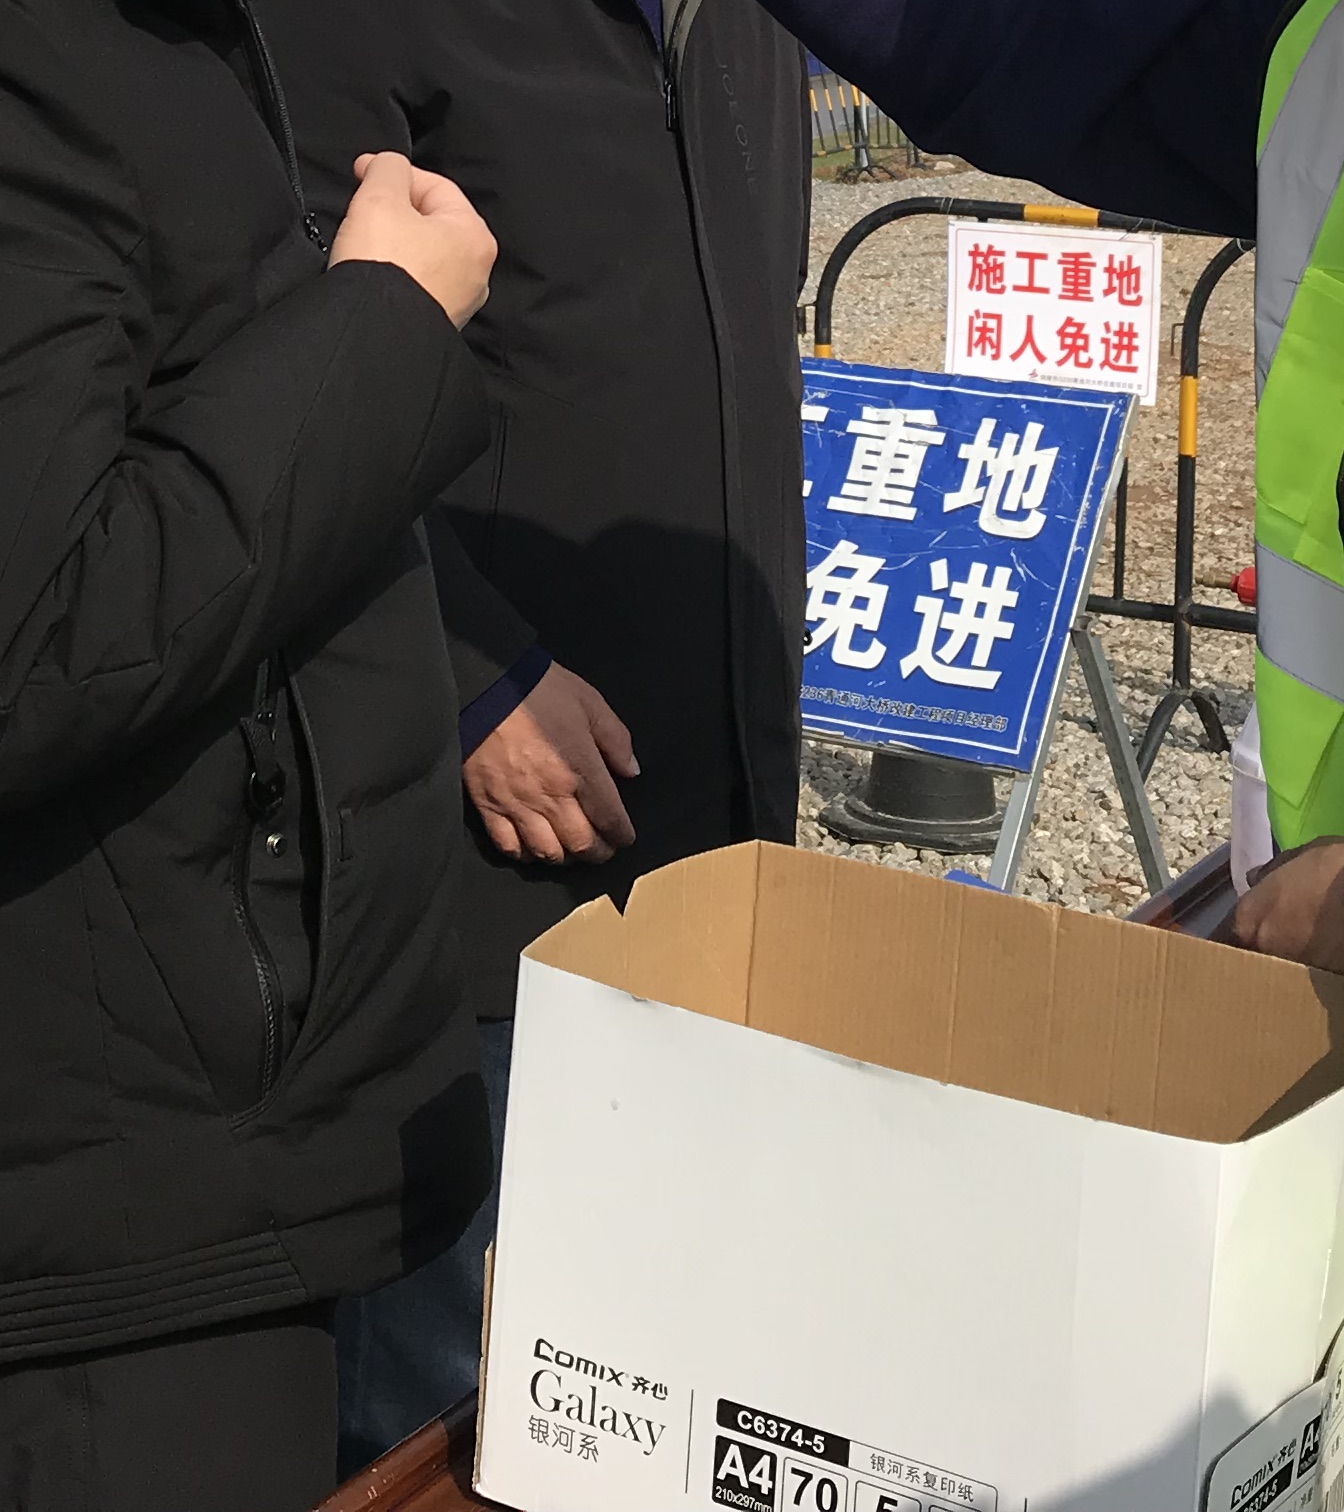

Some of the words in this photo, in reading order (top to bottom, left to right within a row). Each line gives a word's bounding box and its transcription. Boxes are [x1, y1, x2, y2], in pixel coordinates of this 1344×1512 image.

[968, 243, 1143, 307] 施工重地
[967, 309, 1139, 373] 闲人免进
[803, 539, 1019, 690] 免进
[530, 1369, 667, 1456] Galaxy
[631, 1375, 668, 1401] 齐心
[528, 1415, 599, 1463] 银河系
[737, 1410, 826, 1455] C6374-5
[717, 1443, 774, 1496] A4
[790, 1467, 839, 1512] 70
[870, 1453, 975, 1503] 银河系复印纸
